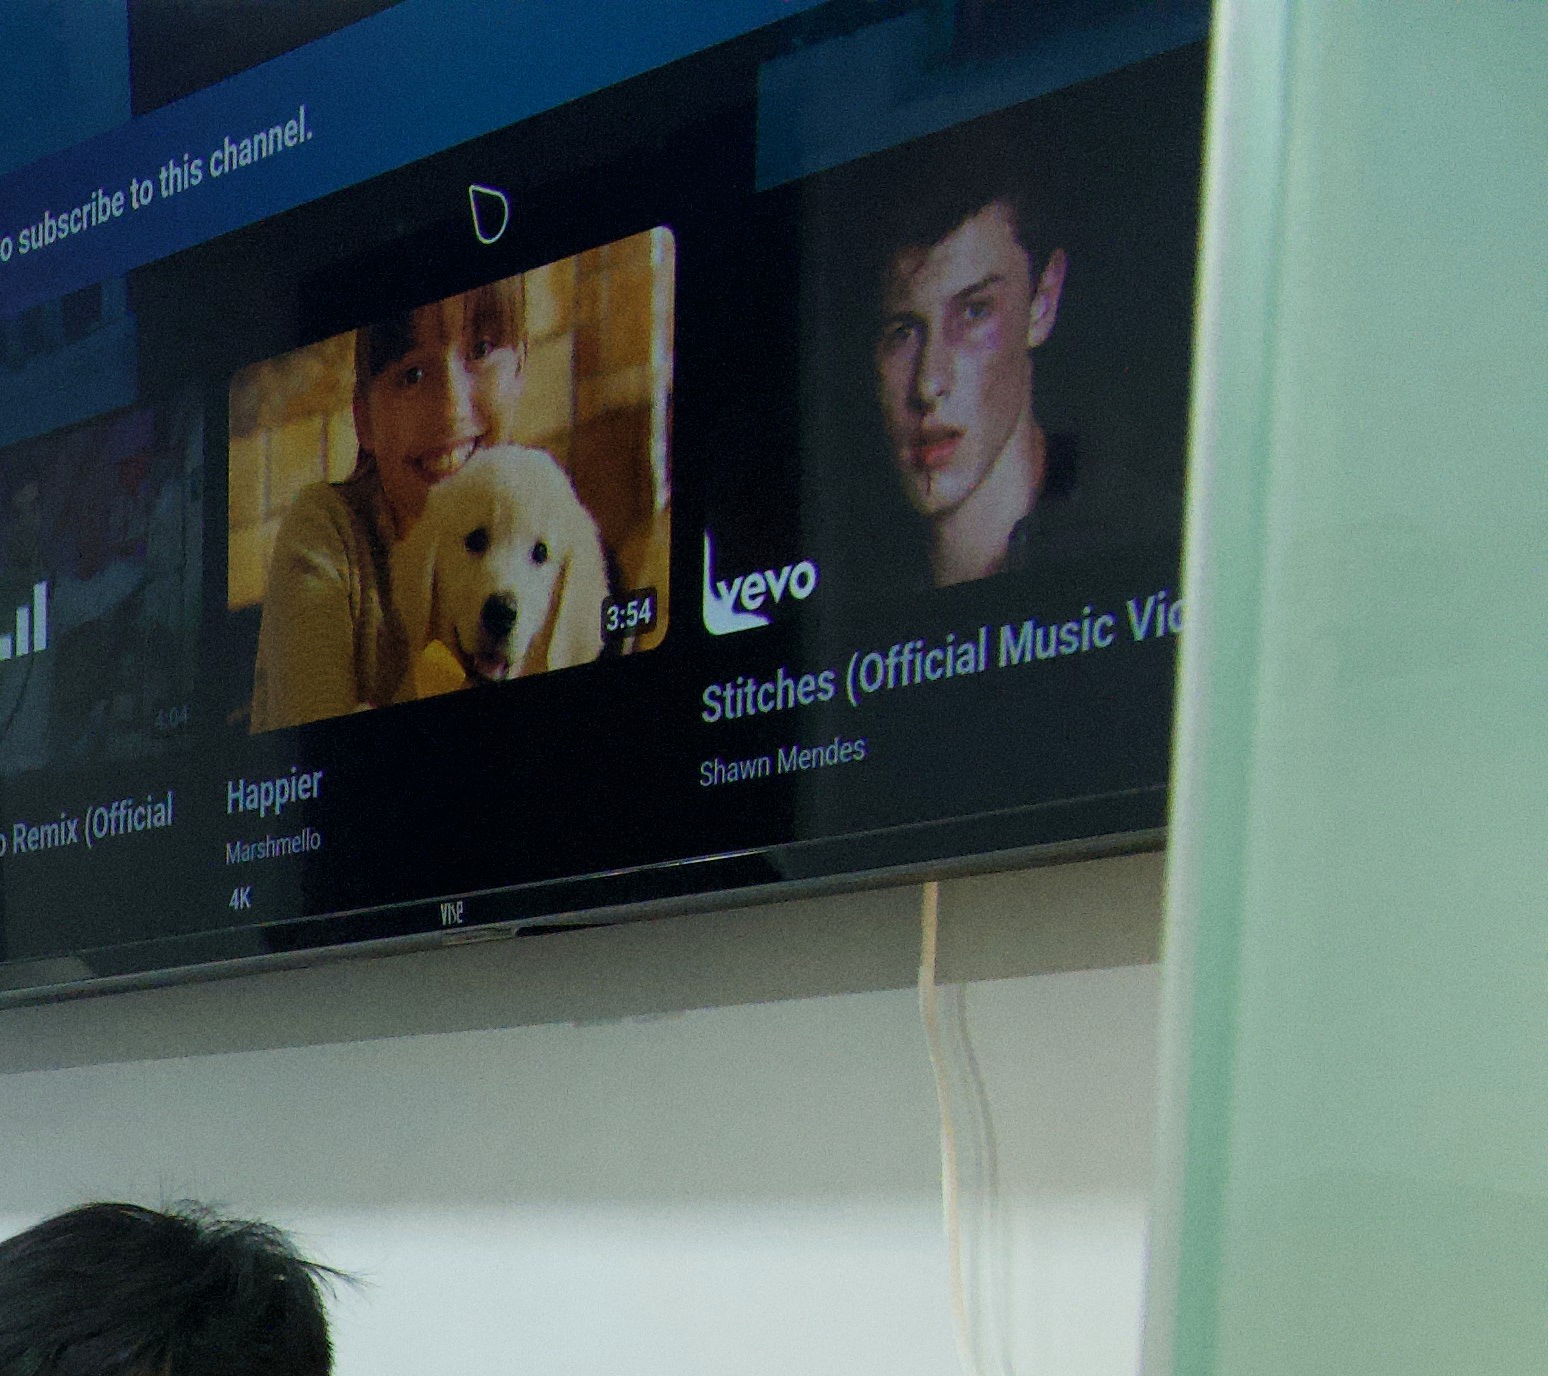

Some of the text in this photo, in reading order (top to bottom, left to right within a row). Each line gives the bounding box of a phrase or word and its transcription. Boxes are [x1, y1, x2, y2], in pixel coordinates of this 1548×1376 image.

[17, 188, 124, 255] subscribe
[130, 178, 153, 209] to
[159, 153, 203, 199] this
[209, 105, 313, 178] channel.
[606, 597, 653, 632] 3:54
[701, 667, 836, 724] Stitches
[846, 626, 990, 707] (Official
[998, 604, 1116, 668] Music
[699, 736, 867, 788] Shawn Mendes
[226, 766, 324, 818] Happier
[12, 811, 80, 855] Remix
[85, 790, 175, 849] (Official
[225, 827, 322, 865] Marshmello
[229, 885, 252, 911] 4K
